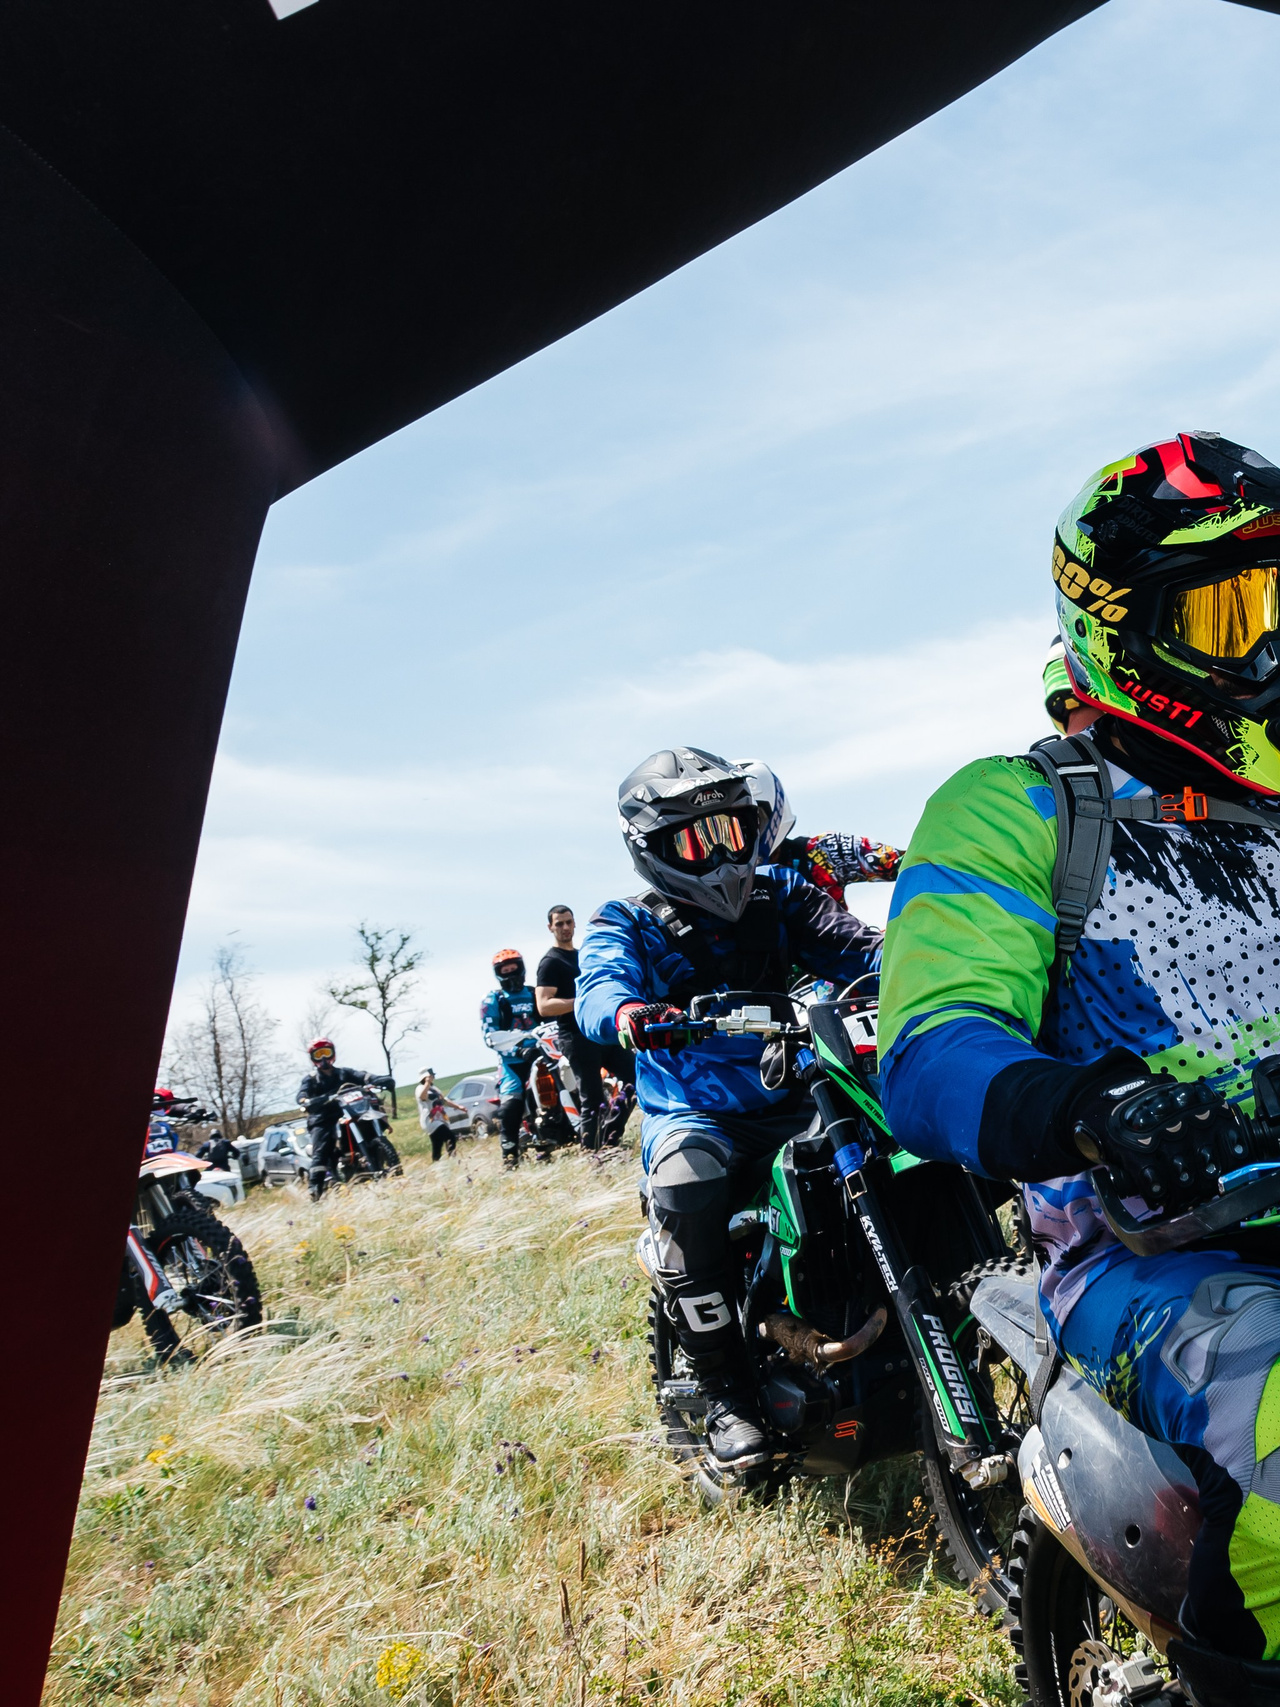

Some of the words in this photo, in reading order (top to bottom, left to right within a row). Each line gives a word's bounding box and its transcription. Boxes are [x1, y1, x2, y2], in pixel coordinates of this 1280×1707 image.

[1115, 680, 1204, 728] JUST1
[693, 789, 725, 804] Airoh
[922, 1314, 980, 1424] PROGASI
